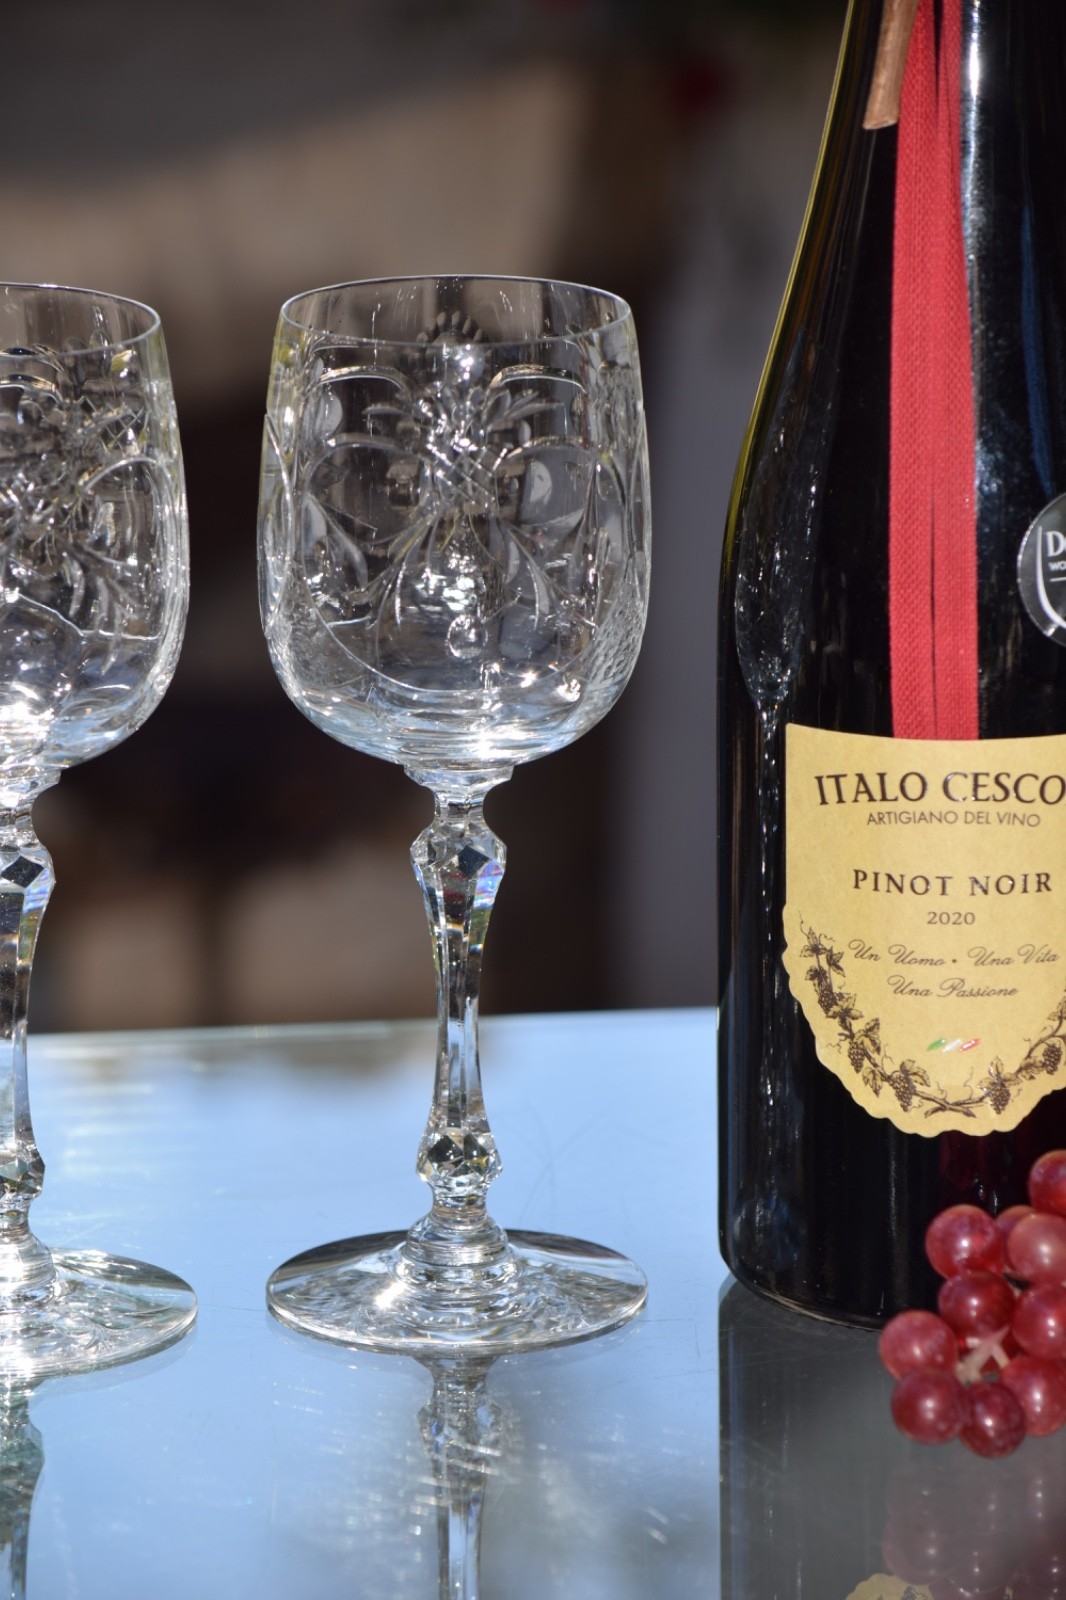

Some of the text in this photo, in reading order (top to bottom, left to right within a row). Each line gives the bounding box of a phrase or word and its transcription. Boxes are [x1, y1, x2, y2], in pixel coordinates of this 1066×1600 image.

[1046, 531, 1066, 557] D
[814, 771, 1066, 806] ITALO CESCO
[867, 810, 1041, 828] ARTIGIANO DEL VINO
[853, 869, 1052, 897] PINOT NOIR
[927, 911, 976, 926] 2020
[848, 939, 1060, 967] Un Uomo Una Vita
[887, 974, 1019, 998] Una Passione
